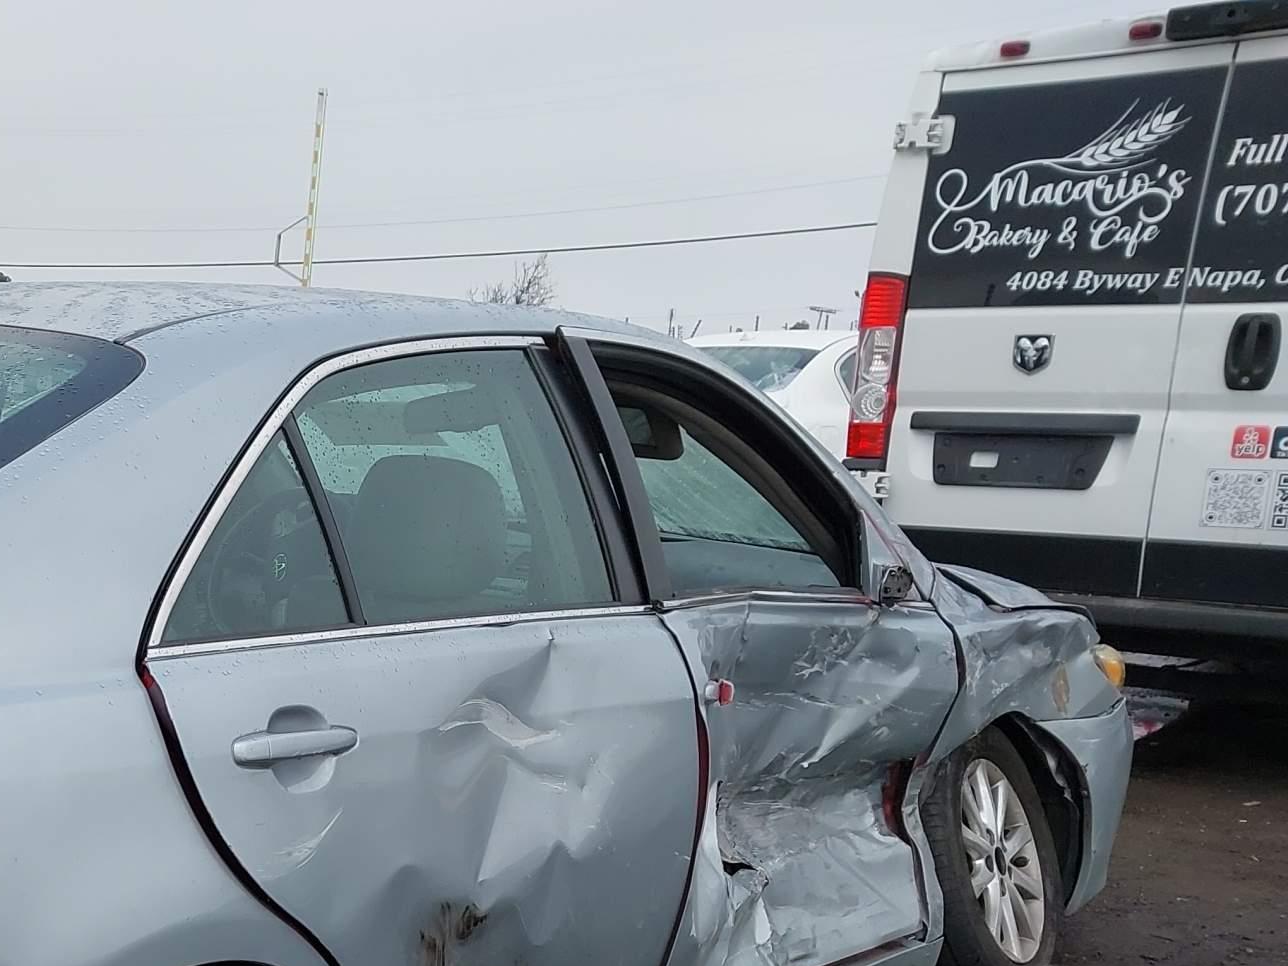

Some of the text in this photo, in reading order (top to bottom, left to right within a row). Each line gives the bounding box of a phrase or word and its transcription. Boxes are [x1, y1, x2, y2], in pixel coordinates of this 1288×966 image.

[1227, 134, 1288, 166] Full
[936, 164, 1192, 222] Macario's
[1215, 183, 1288, 225] (70
[954, 216, 1160, 259] Bakery & Cafe
[1006, 270, 1068, 291] 4084
[1073, 268, 1159, 294] Byway
[1164, 267, 1184, 288] E
[1188, 265, 1266, 292] Napa,
[1234, 443, 1266, 457] yelp
